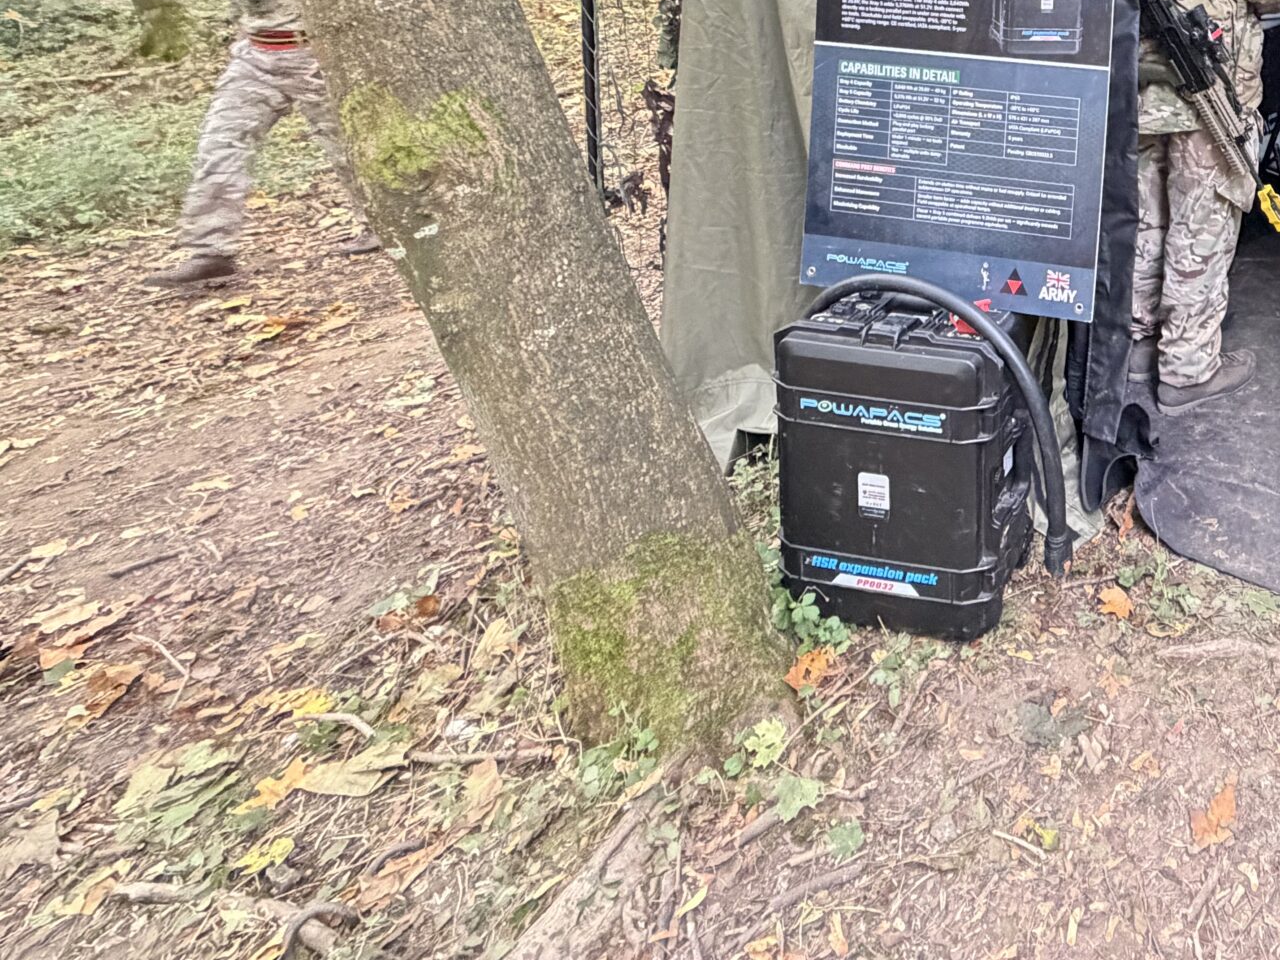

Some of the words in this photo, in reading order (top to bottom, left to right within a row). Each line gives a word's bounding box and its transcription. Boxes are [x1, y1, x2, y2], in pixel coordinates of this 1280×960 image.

[840, 60, 907, 78] CAPABILITIES
[908, 66, 920, 80] IN
[921, 67, 958, 83] DETAIL
[826, 253, 908, 271] POWAPACS
[1037, 285, 1077, 303] ARMY
[800, 397, 943, 427] POWAPACS
[811, 555, 838, 570] HSR
[838, 561, 904, 581] expansion
[904, 571, 938, 586] pack
